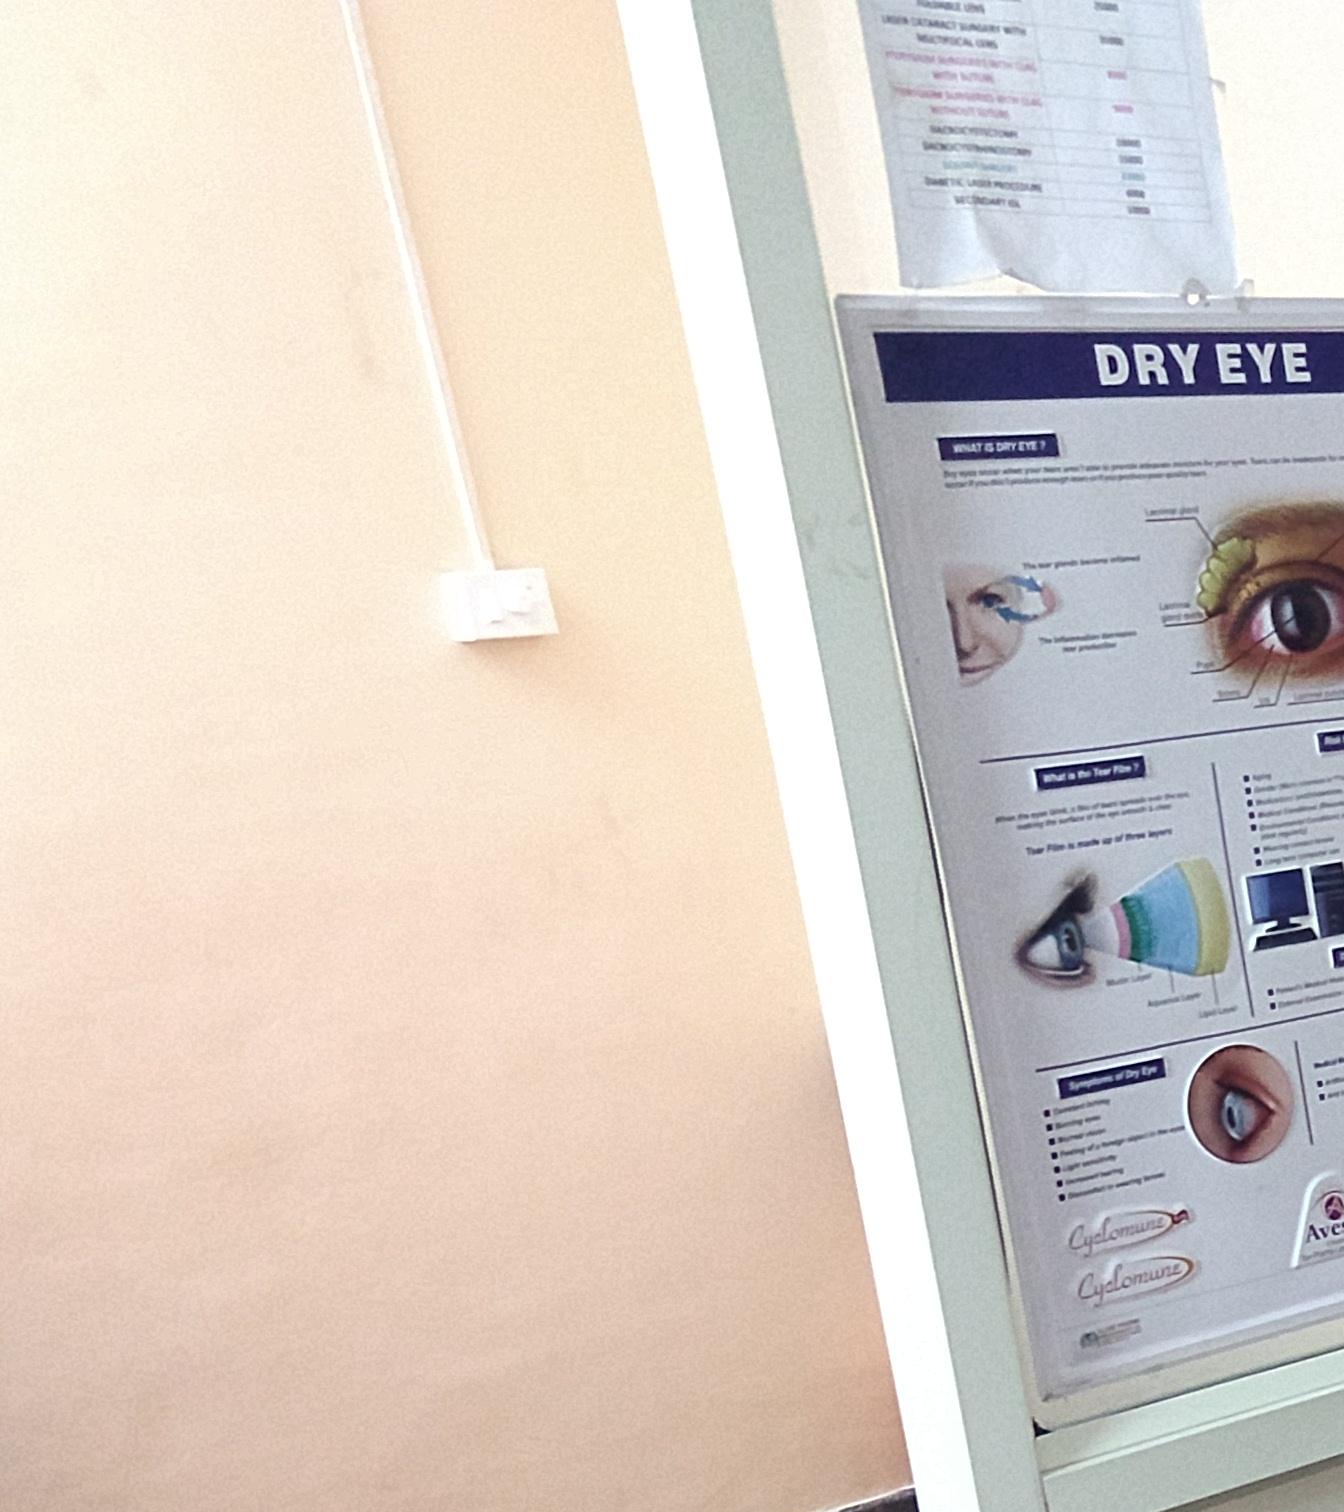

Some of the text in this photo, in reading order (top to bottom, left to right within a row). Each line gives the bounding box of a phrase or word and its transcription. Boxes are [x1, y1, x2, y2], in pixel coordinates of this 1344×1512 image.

[1094, 342, 1312, 386] DRY EYE
[996, 441, 1017, 452] DRY
[1018, 440, 1037, 451] EYE
[1042, 772, 1066, 784] What
[1068, 771, 1076, 781] is
[1077, 768, 1092, 780] the
[1093, 766, 1112, 778] Tear
[1112, 763, 1132, 776] Film
